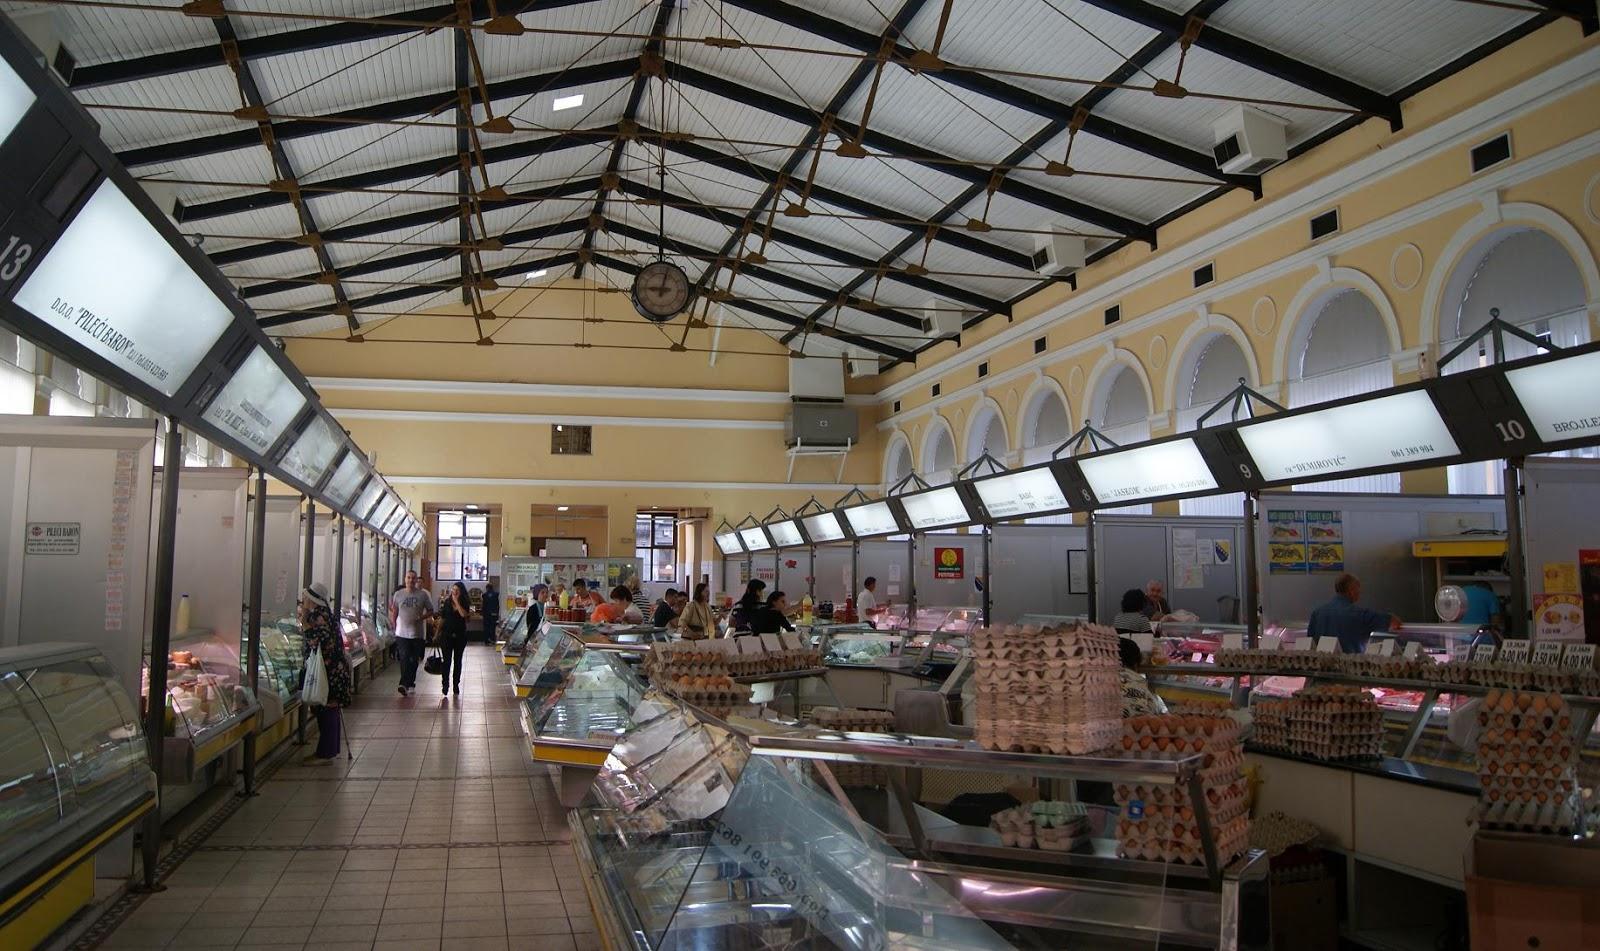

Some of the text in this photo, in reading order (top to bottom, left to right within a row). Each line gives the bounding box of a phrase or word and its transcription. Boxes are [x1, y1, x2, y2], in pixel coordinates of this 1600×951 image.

[0, 235, 32, 281] 13
[51, 298, 74, 319] D.O.O.
[1496, 420, 1526, 442] 10
[1552, 416, 1600, 433] BROJLE
[1239, 463, 1252, 479] 9
[1082, 488, 1091, 502] 8
